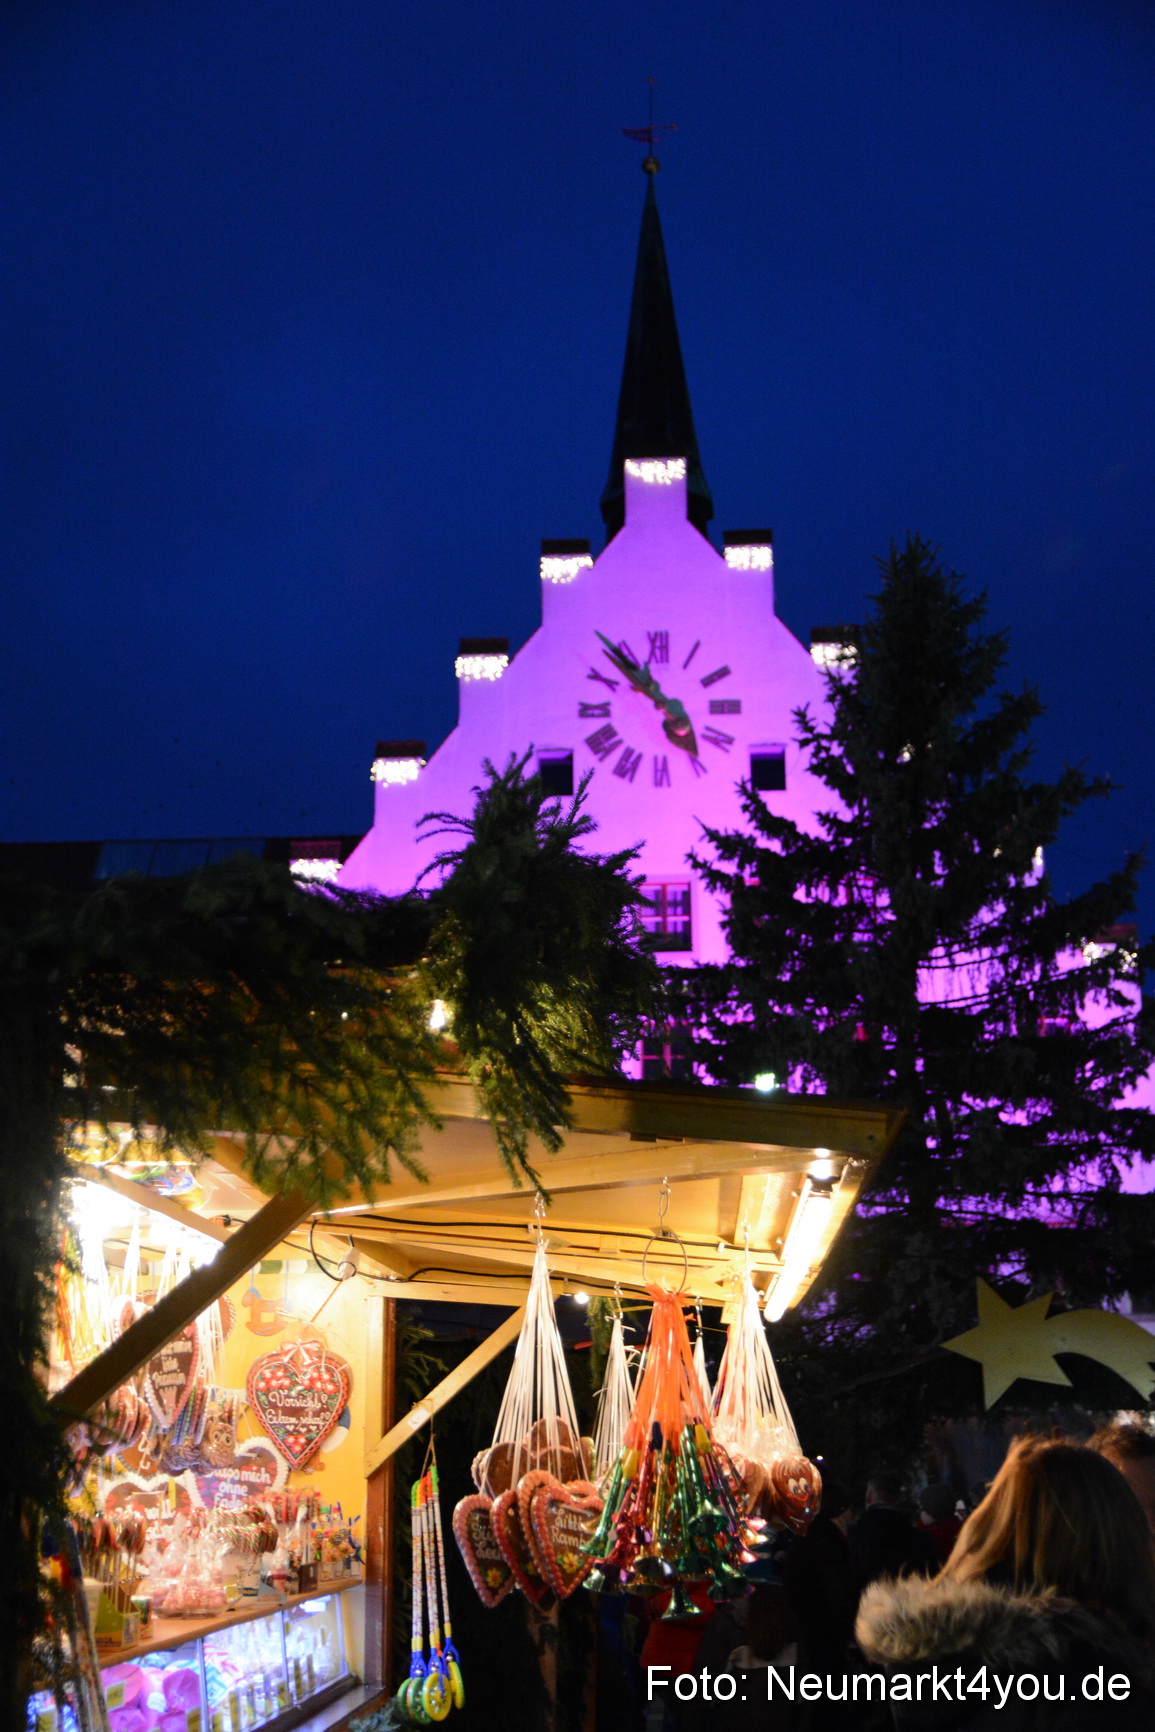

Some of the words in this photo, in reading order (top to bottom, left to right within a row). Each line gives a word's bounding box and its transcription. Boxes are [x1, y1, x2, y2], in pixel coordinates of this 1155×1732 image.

[647, 630, 669, 664] XII
[683, 640, 701, 669] I
[587, 667, 620, 692] X
